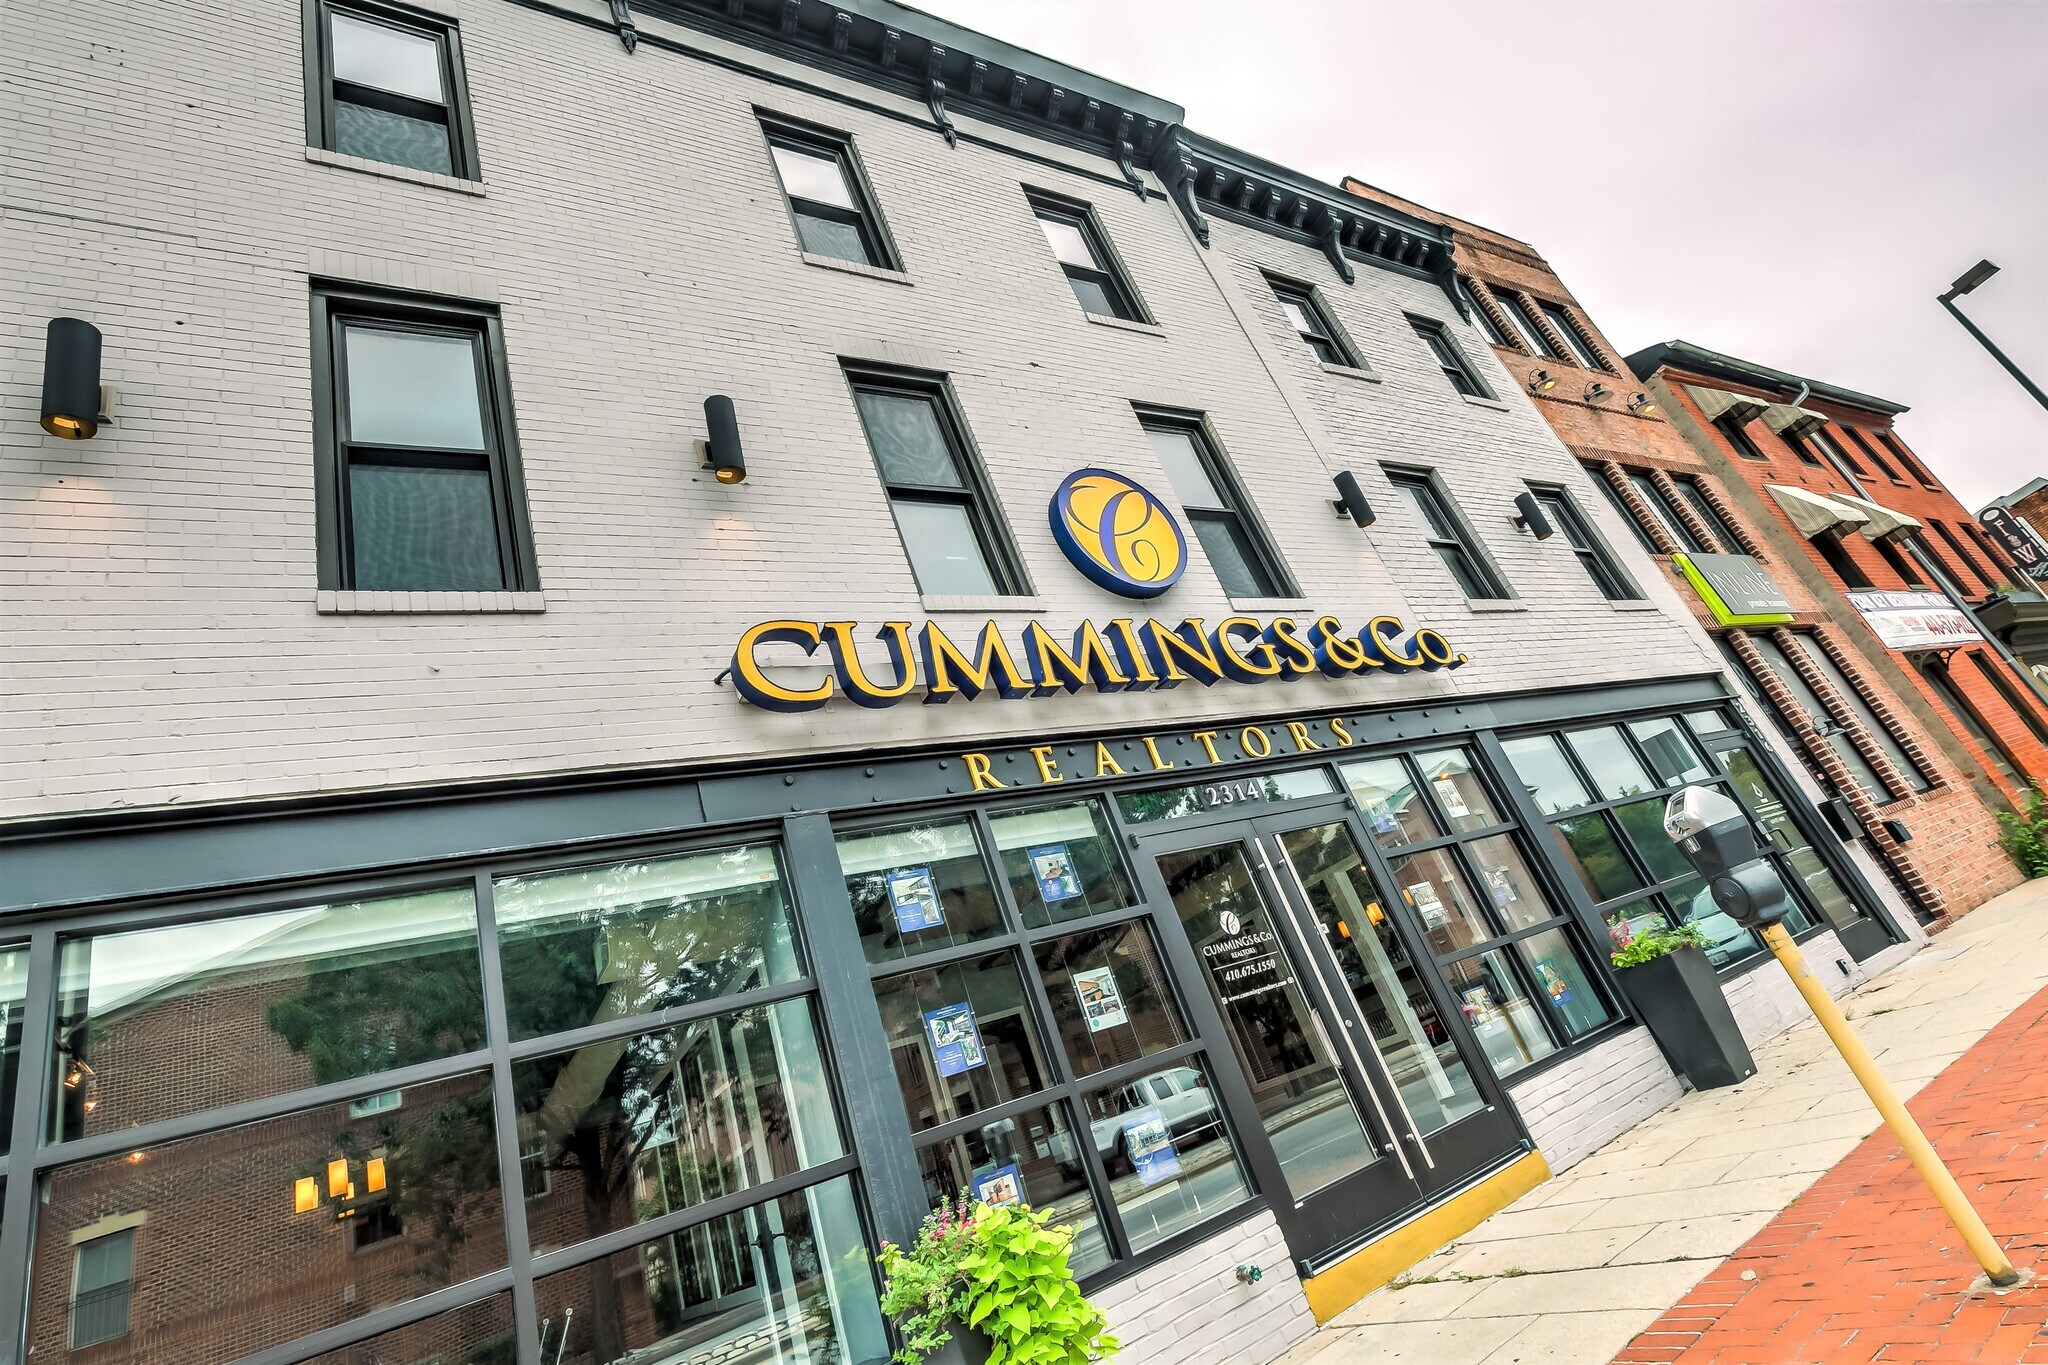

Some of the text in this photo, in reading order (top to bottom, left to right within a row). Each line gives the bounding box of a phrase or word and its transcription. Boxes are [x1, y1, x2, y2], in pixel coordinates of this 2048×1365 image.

[961, 717, 1354, 792] REALTORS
[1205, 781, 1260, 806] 2314
[1231, 947, 1256, 959] REALTORS
[1225, 959, 1276, 981] 410.675.1550
